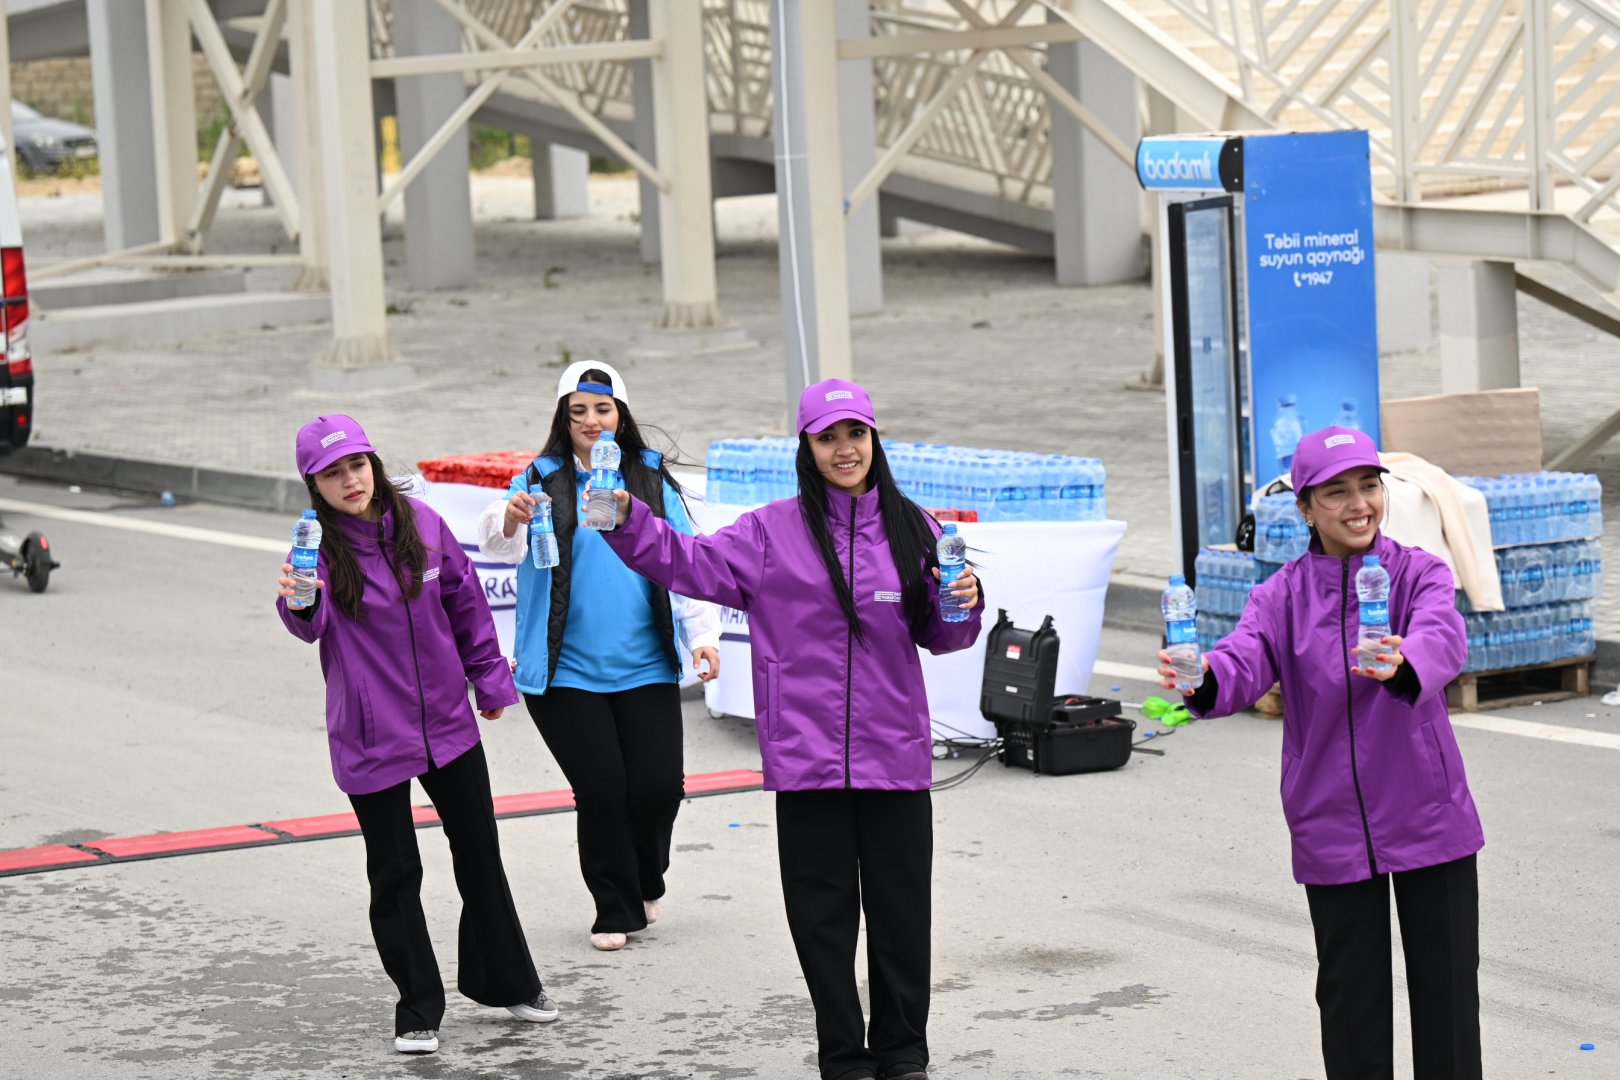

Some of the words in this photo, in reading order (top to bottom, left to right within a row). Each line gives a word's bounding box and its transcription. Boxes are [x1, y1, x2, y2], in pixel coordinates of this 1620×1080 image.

[1264, 232, 1301, 250] Təbii
[1304, 228, 1359, 247] mineral
[1259, 252, 1303, 270] suyun
[1306, 246, 1365, 267] qaynağı
